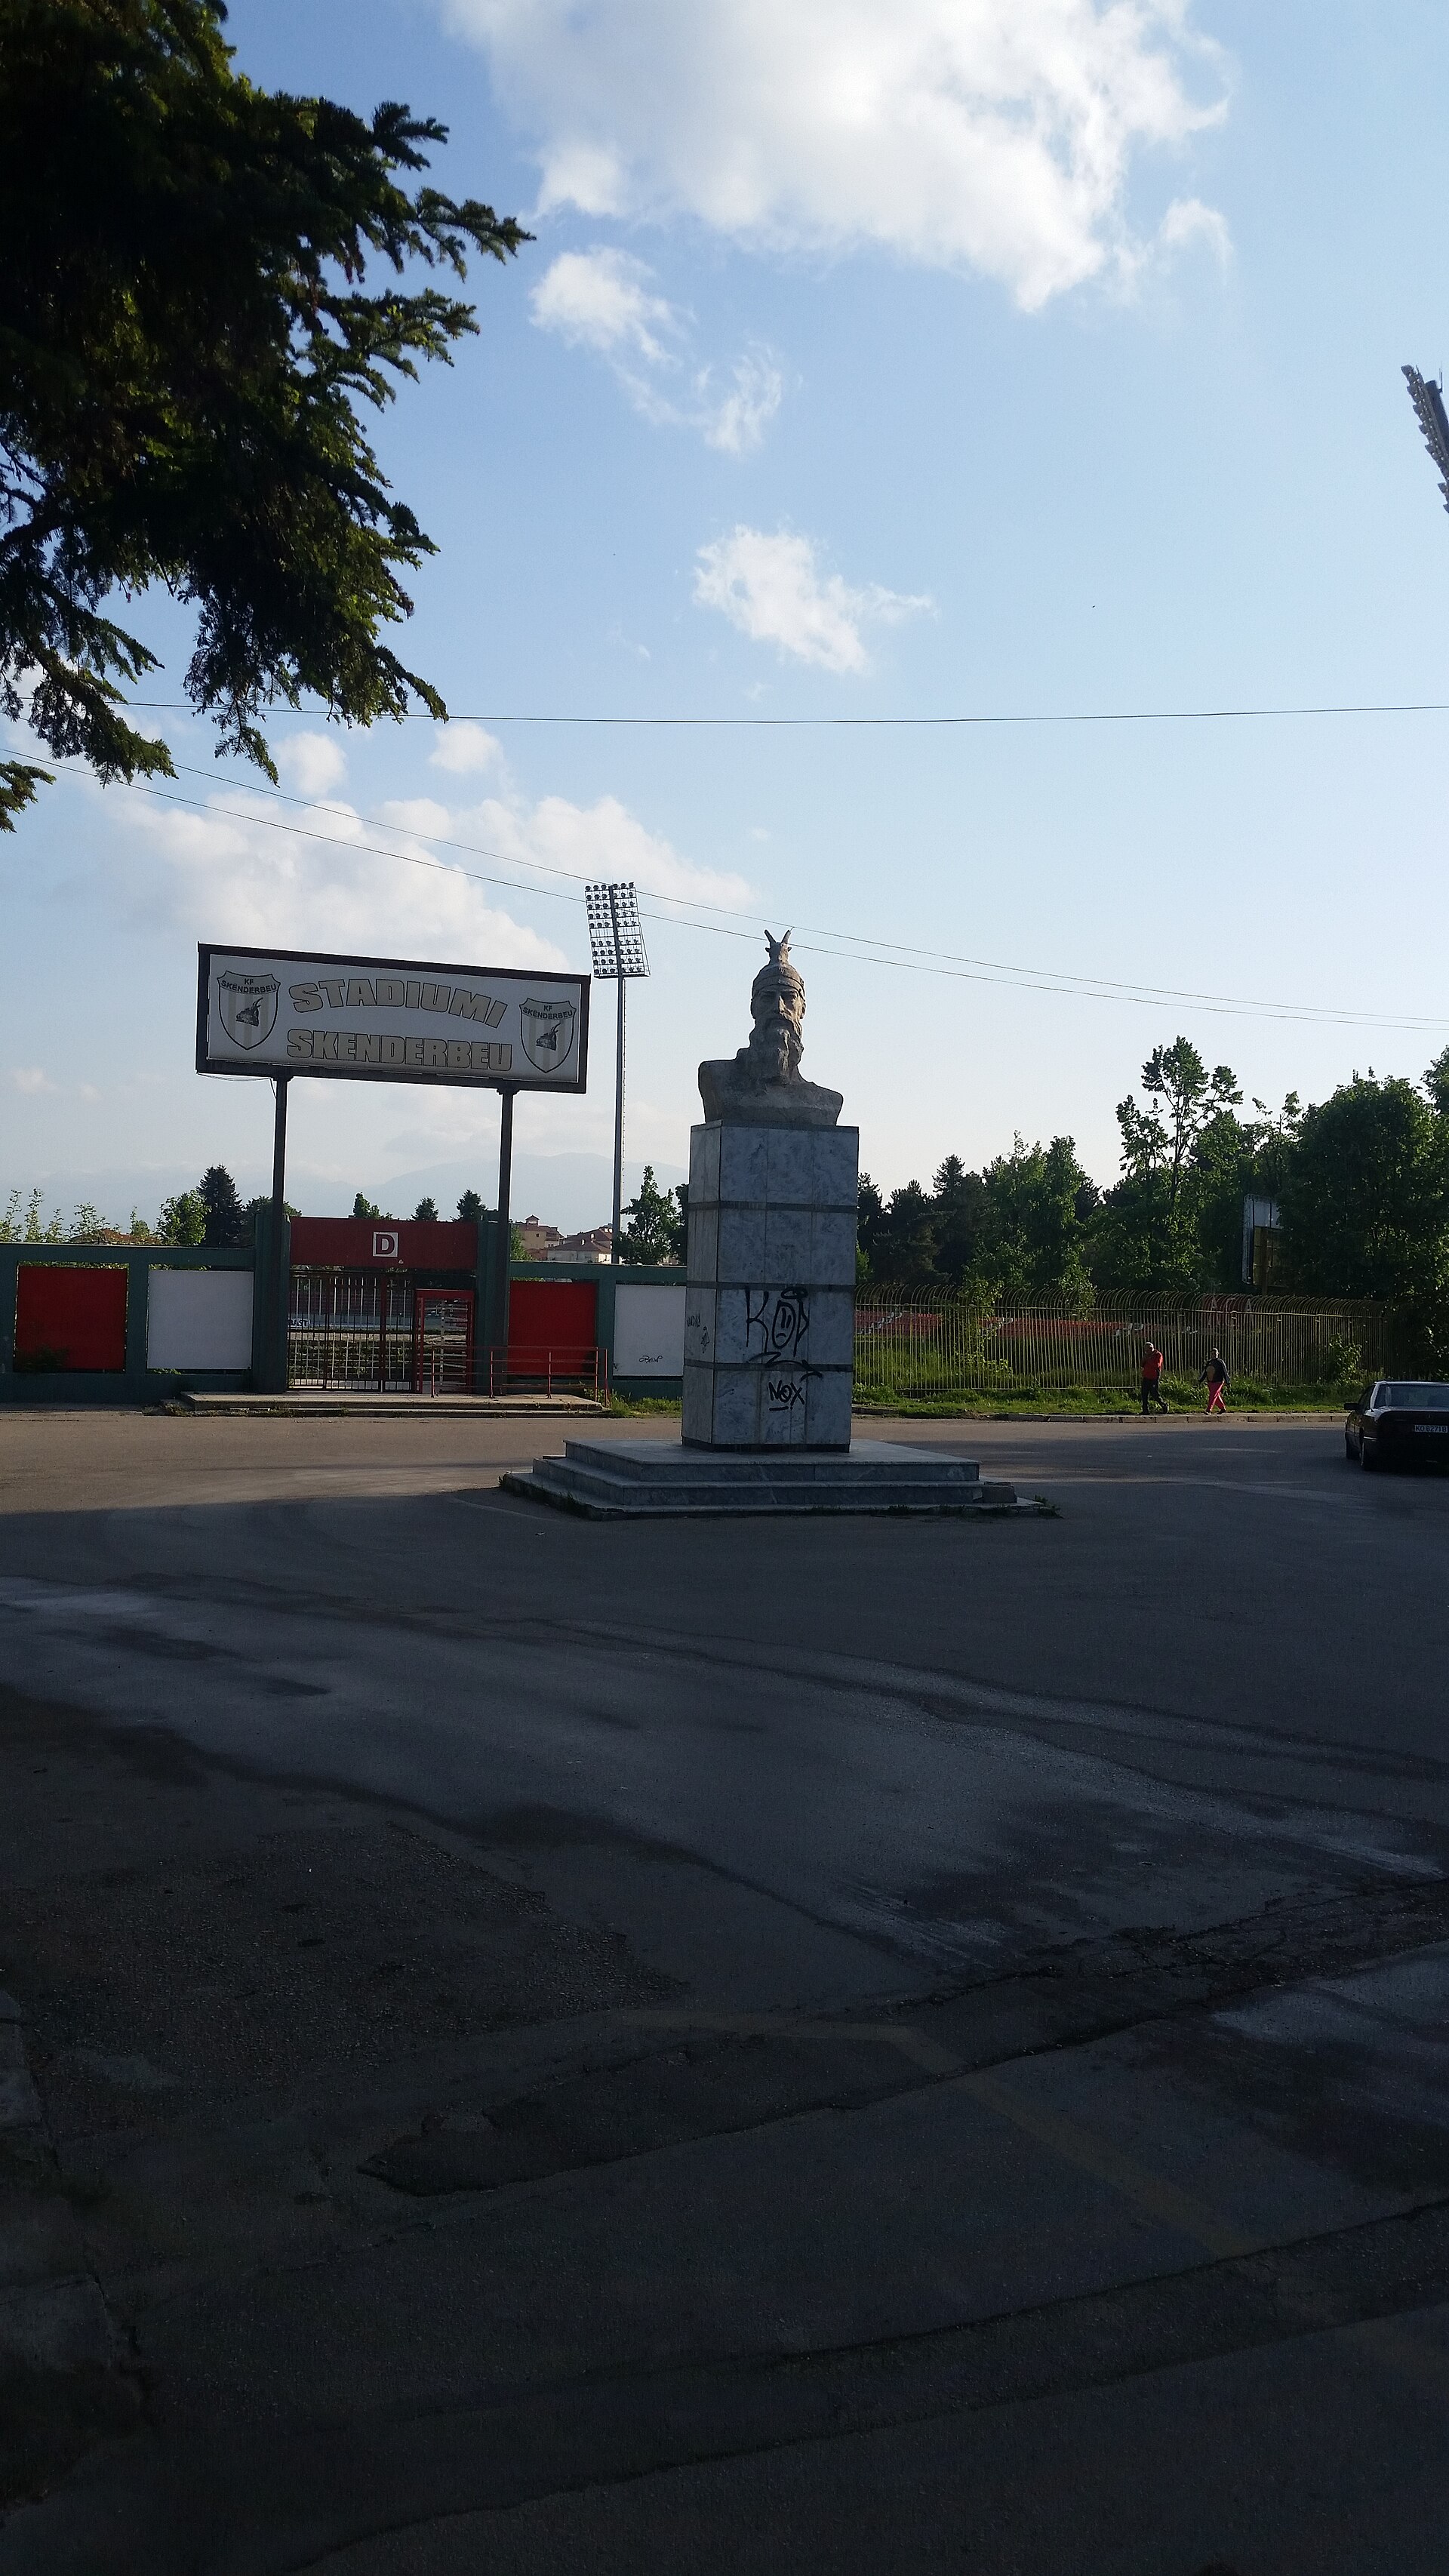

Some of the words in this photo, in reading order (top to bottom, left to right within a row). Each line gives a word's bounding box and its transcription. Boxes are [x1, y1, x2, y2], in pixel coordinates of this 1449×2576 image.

[288, 978, 508, 1028] STADIUMI
[287, 1028, 512, 1072] SKENDERBEU
[376, 1234, 395, 1254] D
